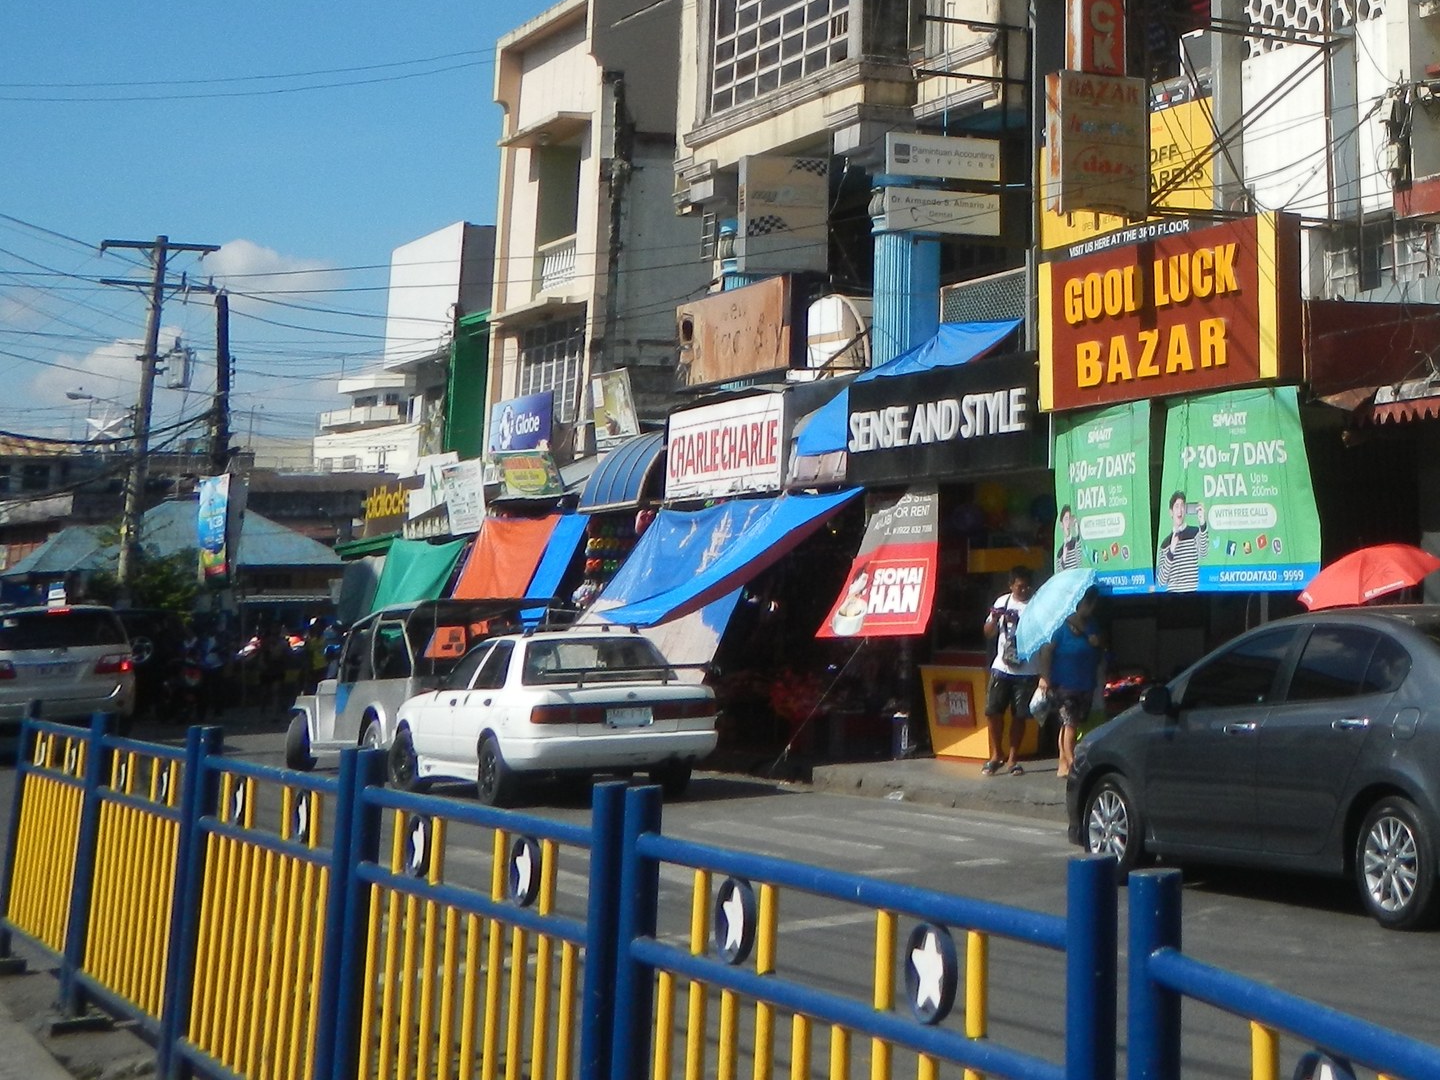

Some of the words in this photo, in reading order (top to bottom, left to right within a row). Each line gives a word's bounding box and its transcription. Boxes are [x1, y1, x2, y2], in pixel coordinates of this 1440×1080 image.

[912, 145, 953, 158] Pamintuan
[954, 149, 996, 161] Accounting
[1069, 245, 1085, 258] VISIT
[1085, 241, 1094, 254] US
[1094, 236, 1111, 251] HERE
[1110, 232, 1122, 247] AT
[1121, 228, 1137, 243] THE
[1157, 219, 1190, 236] FLOOR
[1063, 264, 1143, 325] GOOD
[1152, 242, 1240, 308] LUCK
[1076, 316, 1229, 390] BAZAR
[515, 413, 540, 435] Globe
[848, 406, 910, 453] SENSE
[909, 399, 961, 445] AND
[960, 386, 1027, 439] STYLE
[1212, 410, 1248, 428] SMART
[1087, 426, 1114, 444] SMART
[1096, 458, 1104, 481] 7
[1105, 451, 1136, 479] DAYS
[1218, 450, 1231, 463] for
[1230, 442, 1241, 467] 7
[1243, 439, 1288, 466] DAYS
[1077, 485, 1107, 511] DATA
[1203, 473, 1248, 498] DATA
[1250, 472, 1261, 484] Up
[895, 506, 909, 519] OR
[1214, 508, 1233, 518] WITH
[1233, 508, 1250, 518] FREE
[1250, 506, 1269, 517] CALLS
[873, 566, 925, 585] SIOMAI
[1219, 570, 1278, 583] SAKTODATA30
[1283, 569, 1305, 582] 9999
[867, 584, 921, 614] HAN
